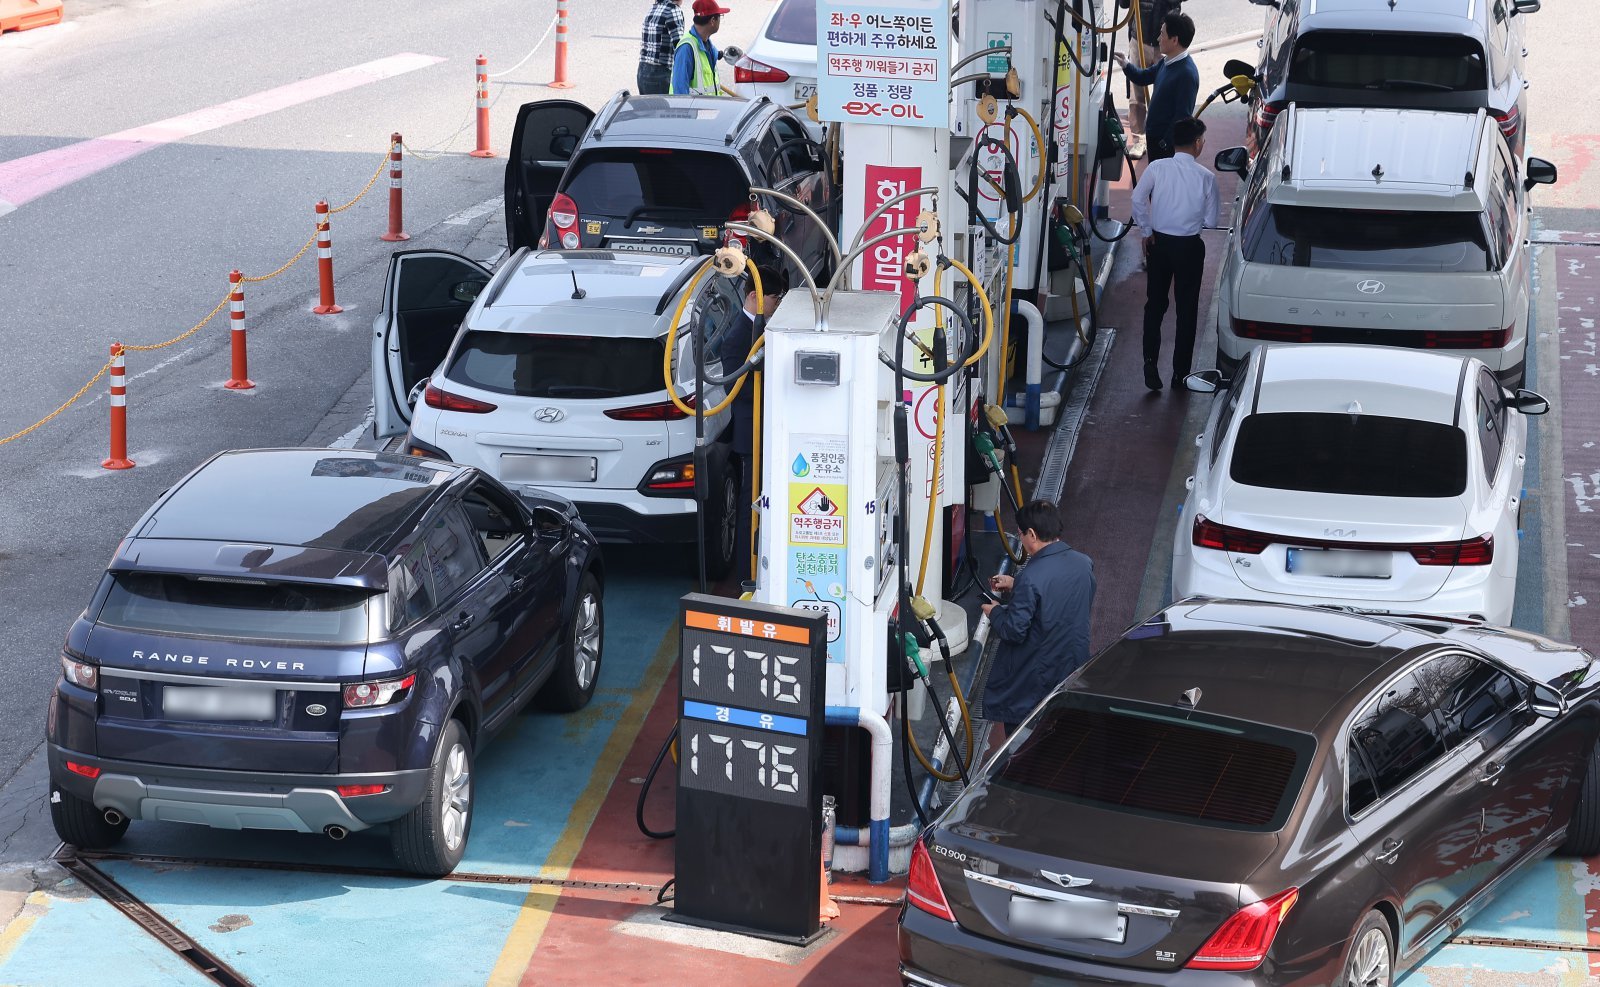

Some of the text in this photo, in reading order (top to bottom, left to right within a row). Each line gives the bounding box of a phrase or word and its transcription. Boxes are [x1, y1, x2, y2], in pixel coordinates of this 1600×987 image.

[831, 13, 933, 33] 좌·우 어느쪽이든
[827, 31, 937, 49] 편하게 주유하세요
[830, 58, 934, 75] 역주행 끼워들기 금지
[957, 121, 962, 132] 6
[1287, 307, 1395, 320] SANTA
[811, 452, 846, 464] 품질인증
[815, 464, 842, 474] 주유소
[762, 495, 770, 510] 14
[865, 500, 876, 515] 15
[793, 517, 842, 530] 역주행금지
[796, 552, 839, 564] 탄소중립
[795, 563, 839, 575] 실천하기
[132, 650, 306, 671] RANGE ROVER
[692, 644, 801, 704] 1776
[690, 733, 799, 793] 1776
